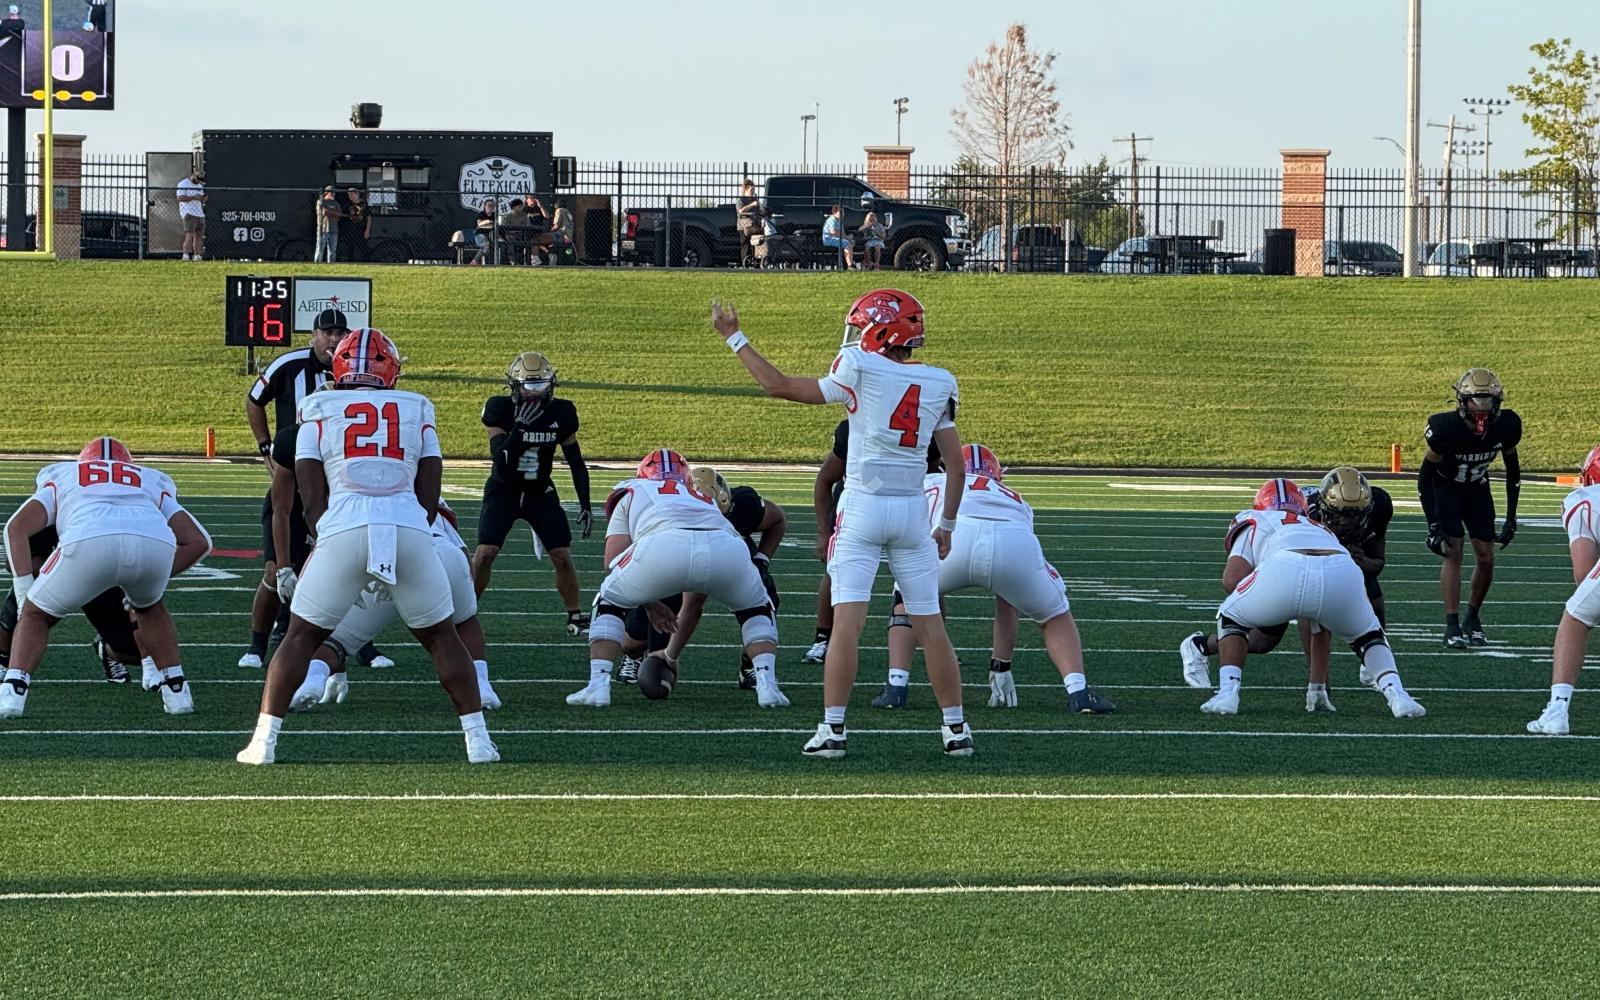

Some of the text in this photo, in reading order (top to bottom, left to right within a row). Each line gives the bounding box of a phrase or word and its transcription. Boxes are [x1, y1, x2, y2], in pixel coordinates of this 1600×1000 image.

[51, 44, 84, 81] 0
[463, 180, 531, 195] EL TEXICAN
[237, 280, 287, 298] 11:25
[248, 303, 284, 341] 16
[344, 402, 405, 460] 21
[889, 383, 921, 448] 4
[78, 461, 141, 488] 66
